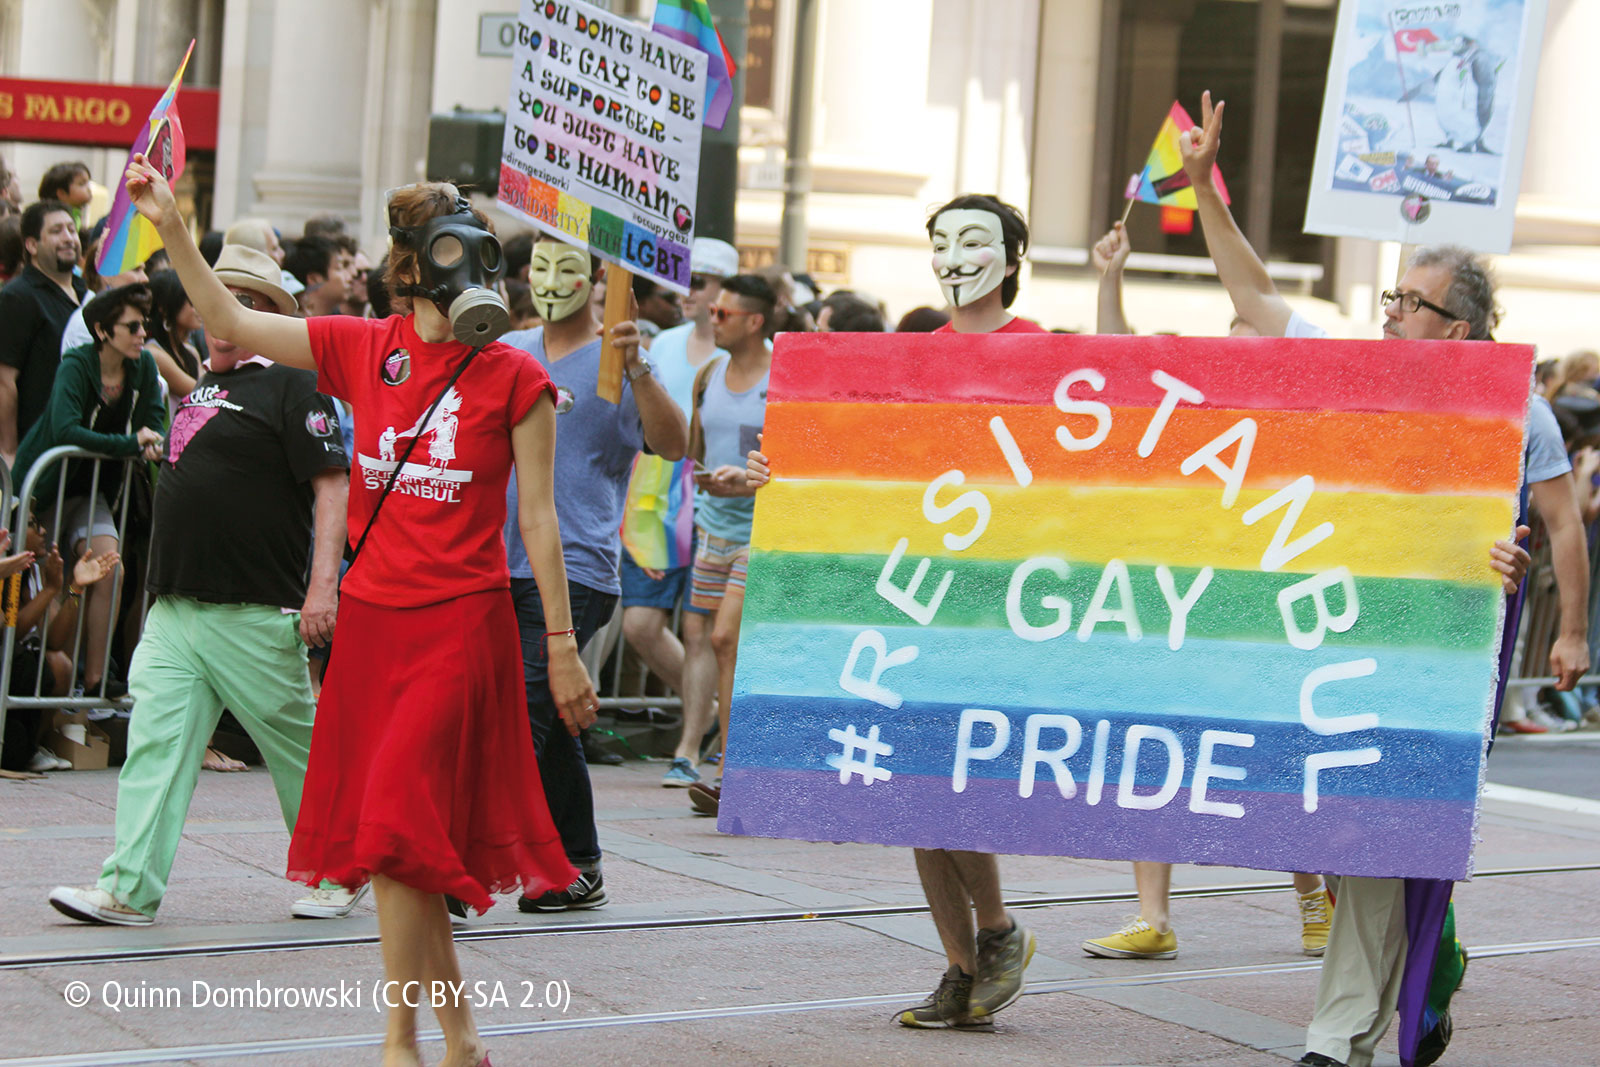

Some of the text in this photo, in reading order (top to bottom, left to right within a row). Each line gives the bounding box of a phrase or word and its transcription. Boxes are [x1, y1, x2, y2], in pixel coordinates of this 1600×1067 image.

[518, 21, 695, 121] TO BE GAY TO BE
[533, 0, 695, 82] YOU DON'T HAVE
[25, 93, 131, 126] FARGO
[514, 125, 538, 155] TO
[545, 139, 570, 170] BE
[518, 89, 680, 182] YOU JUST HAVE
[521, 60, 534, 83] A
[540, 68, 665, 142] SUPPORTER
[502, 183, 683, 280] SOLIDARITY WITH LGBT
[429, 478, 460, 490] WITH
[839, 368, 1382, 813] RESISTANBUL
[1006, 556, 1214, 651] GAY
[952, 708, 1256, 819] PRIDE
